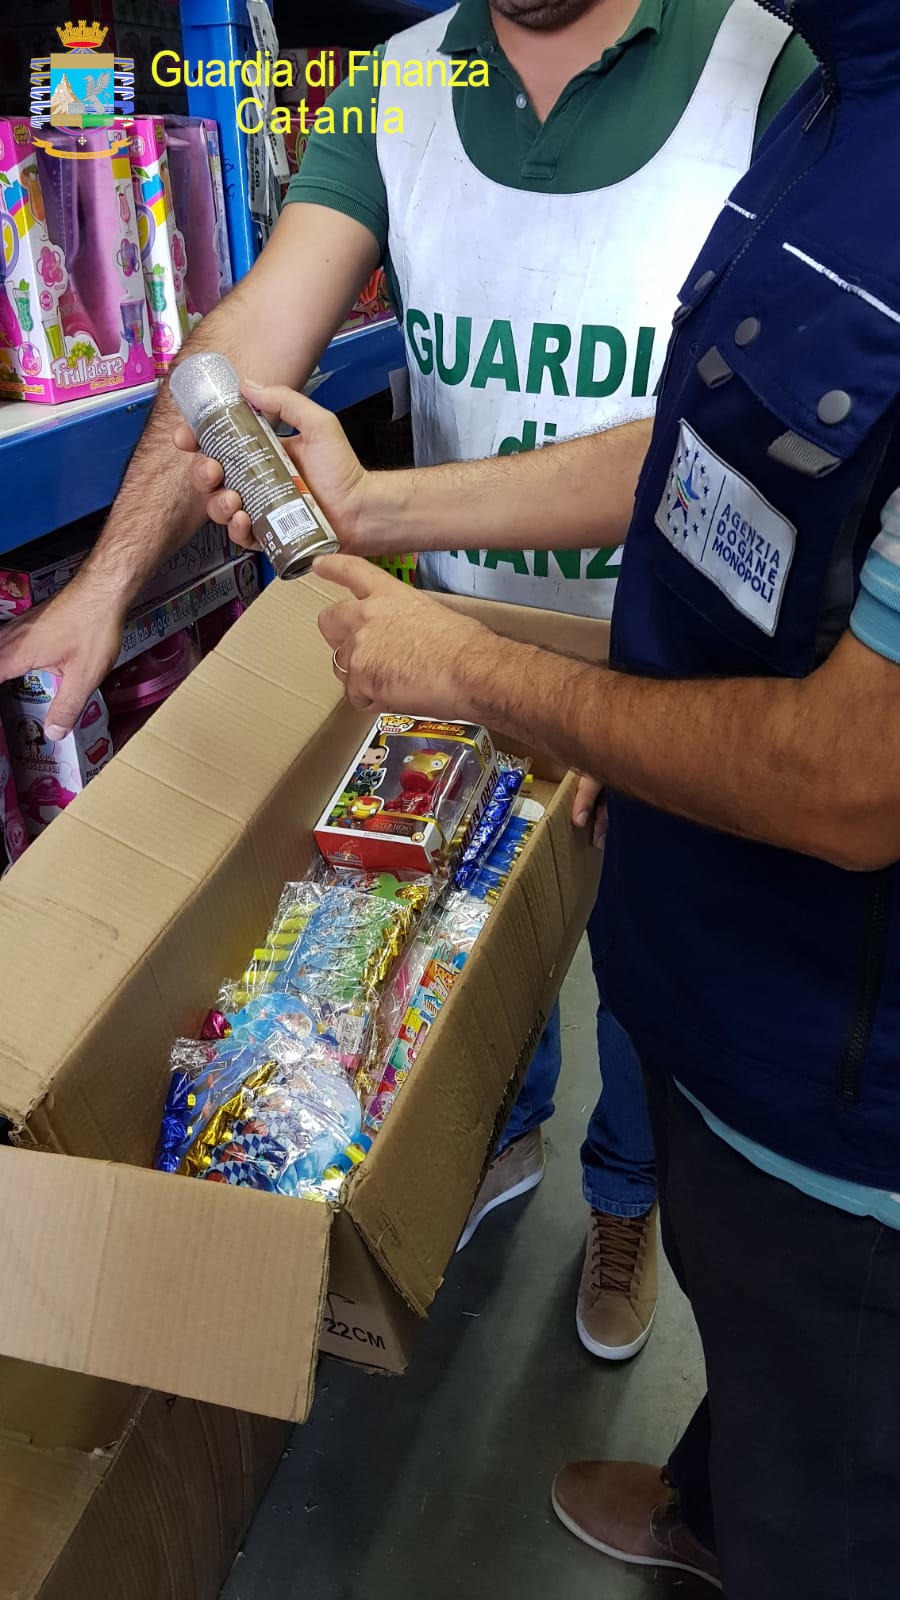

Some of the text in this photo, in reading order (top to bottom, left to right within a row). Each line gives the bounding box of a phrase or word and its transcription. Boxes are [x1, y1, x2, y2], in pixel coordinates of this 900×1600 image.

[406, 308, 660, 398] GUARDI
[711, 536, 774, 604] MONOPOLI
[716, 519, 778, 587] DOGANE
[721, 503, 780, 569] AGENZIA
[323, 1317, 387, 1351] 22CM
